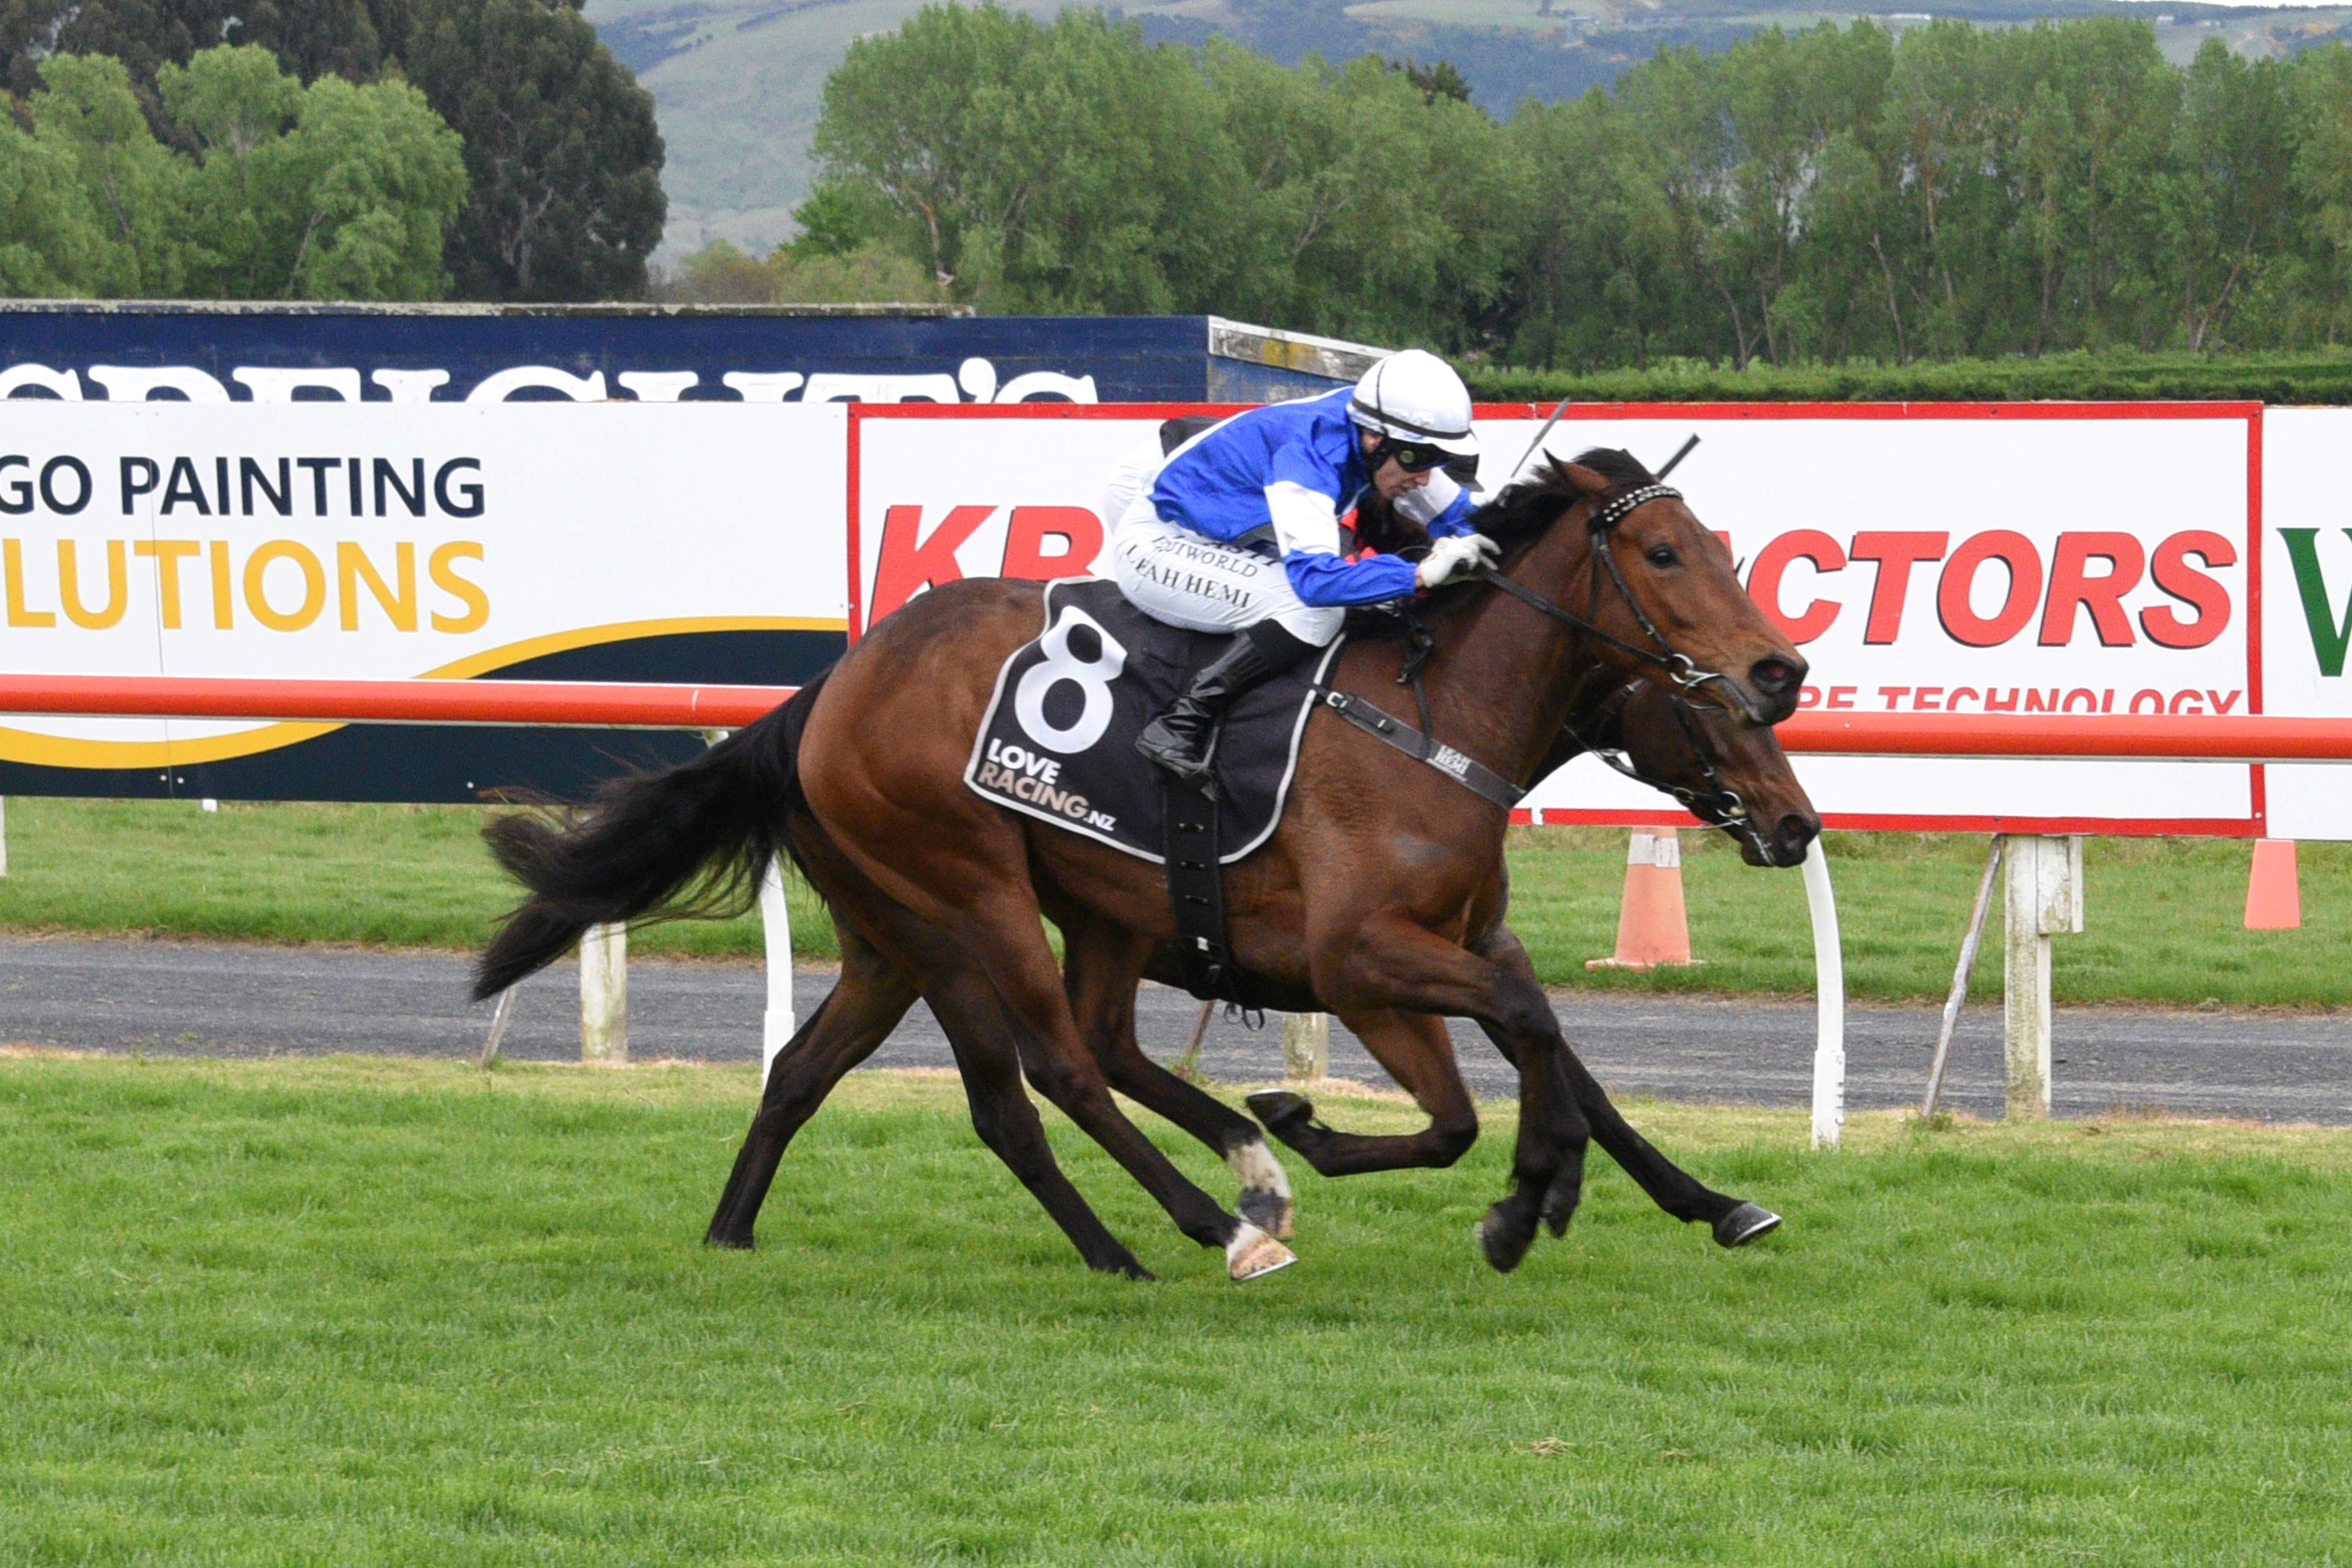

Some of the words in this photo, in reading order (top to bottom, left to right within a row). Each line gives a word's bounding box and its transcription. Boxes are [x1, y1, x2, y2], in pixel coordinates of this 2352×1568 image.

[0, 454, 93, 516] GO
[120, 456, 485, 518] PAINTING
[3, 538, 490, 634] LUTIONS
[1185, 573, 1252, 609] HEMI
[1015, 605, 1128, 754] 8
[987, 738, 1062, 785] LOVE
[977, 761, 1117, 832] RACING.NZ
